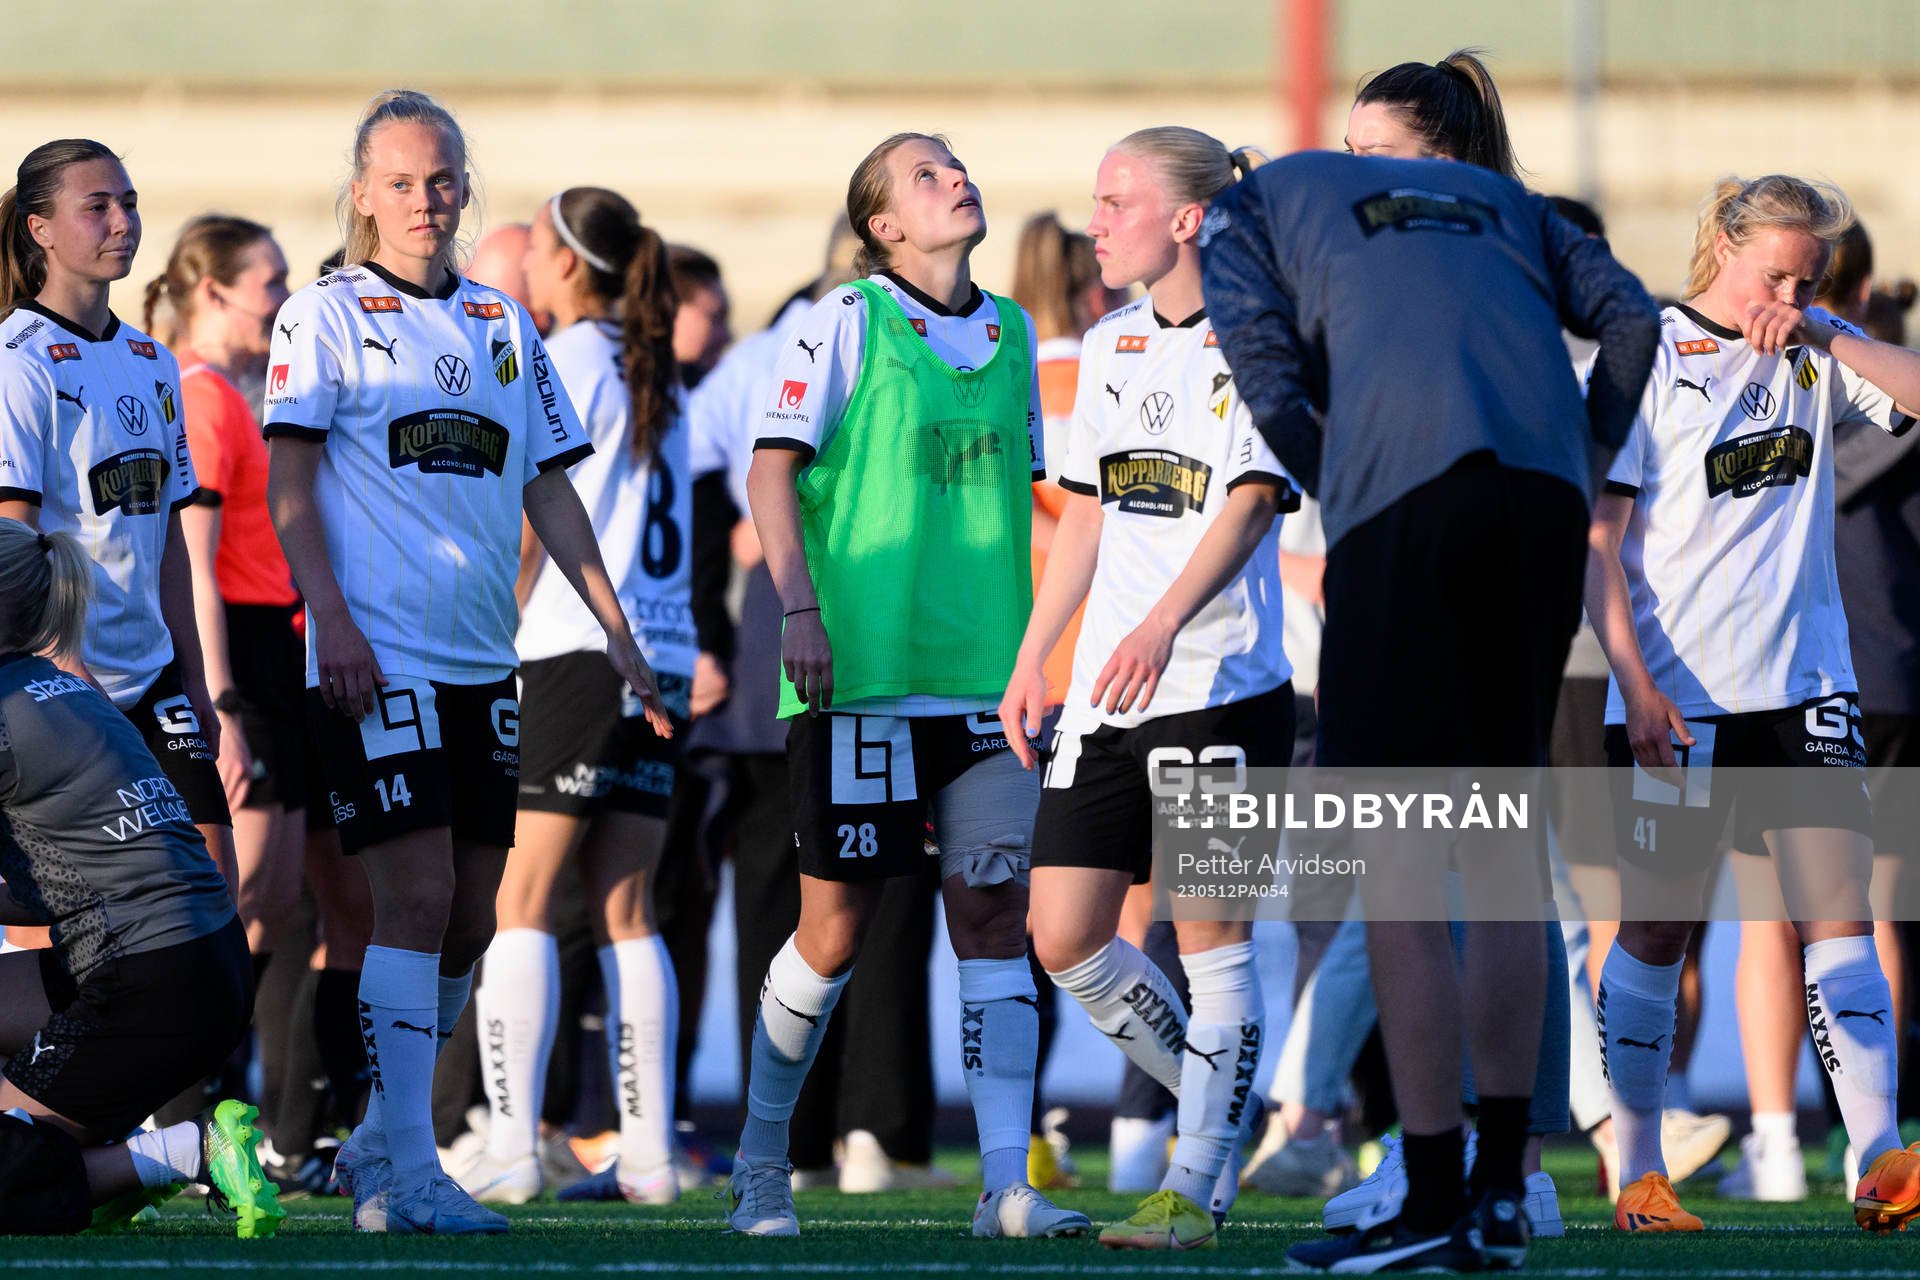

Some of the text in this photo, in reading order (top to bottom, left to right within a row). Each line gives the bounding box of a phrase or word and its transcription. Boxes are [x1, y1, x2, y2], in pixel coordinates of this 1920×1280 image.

[399, 419, 500, 463] KOPPARBERG
[1107, 459, 1207, 502] KOPPARBERG
[971, 738, 1013, 752] GÅRD
[1805, 741, 1850, 756] GÅRDA
[375, 774, 412, 812] 14
[837, 823, 878, 858] 28
[1633, 816, 1656, 852] 41
[1807, 983, 1841, 1074] MAXXIS
[488, 1019, 513, 1118] MAXXIS
[619, 1023, 643, 1119] MAXXIS
[1227, 1023, 1261, 1127] MAXXIS
